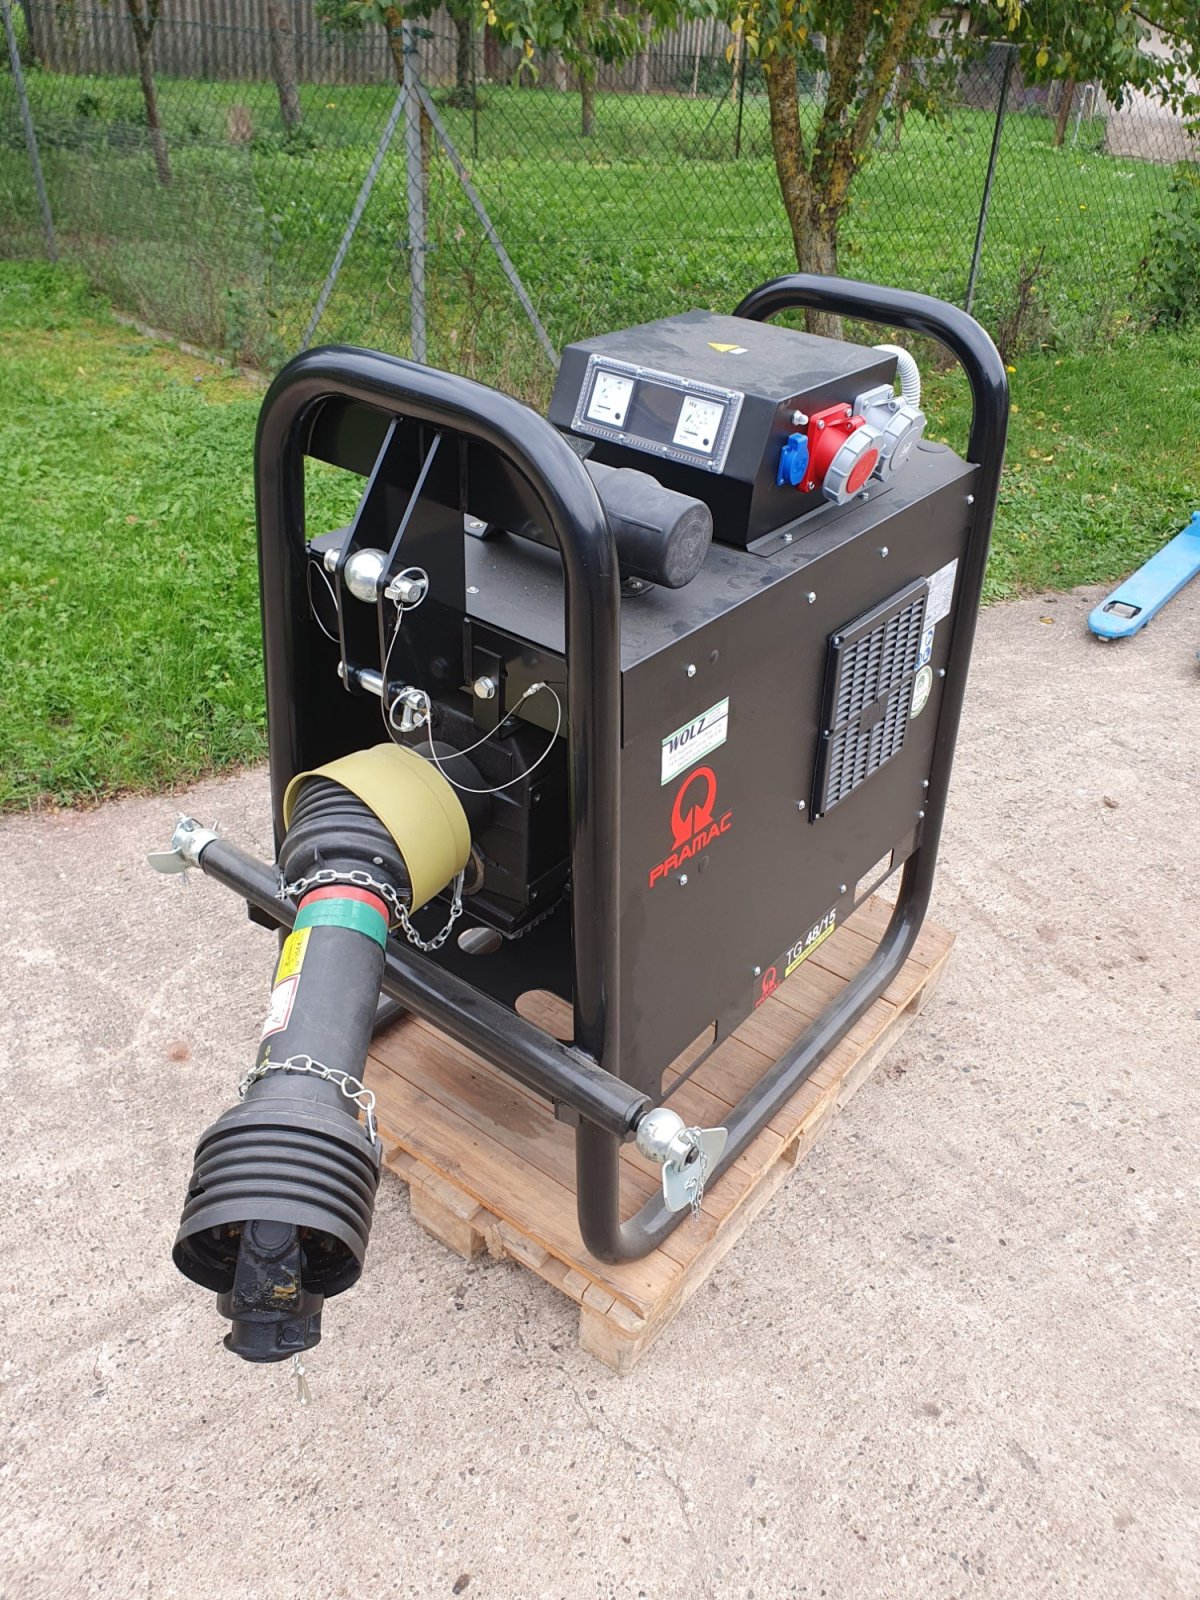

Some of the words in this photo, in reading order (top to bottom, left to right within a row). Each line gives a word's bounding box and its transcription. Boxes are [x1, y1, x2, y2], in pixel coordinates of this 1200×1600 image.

[688, 400, 698, 409] Hz
[667, 718, 706, 754] WOLZ
[649, 810, 733, 888] PRAMAC
[786, 940, 803, 966] TG
[805, 908, 837, 946] 48/15
